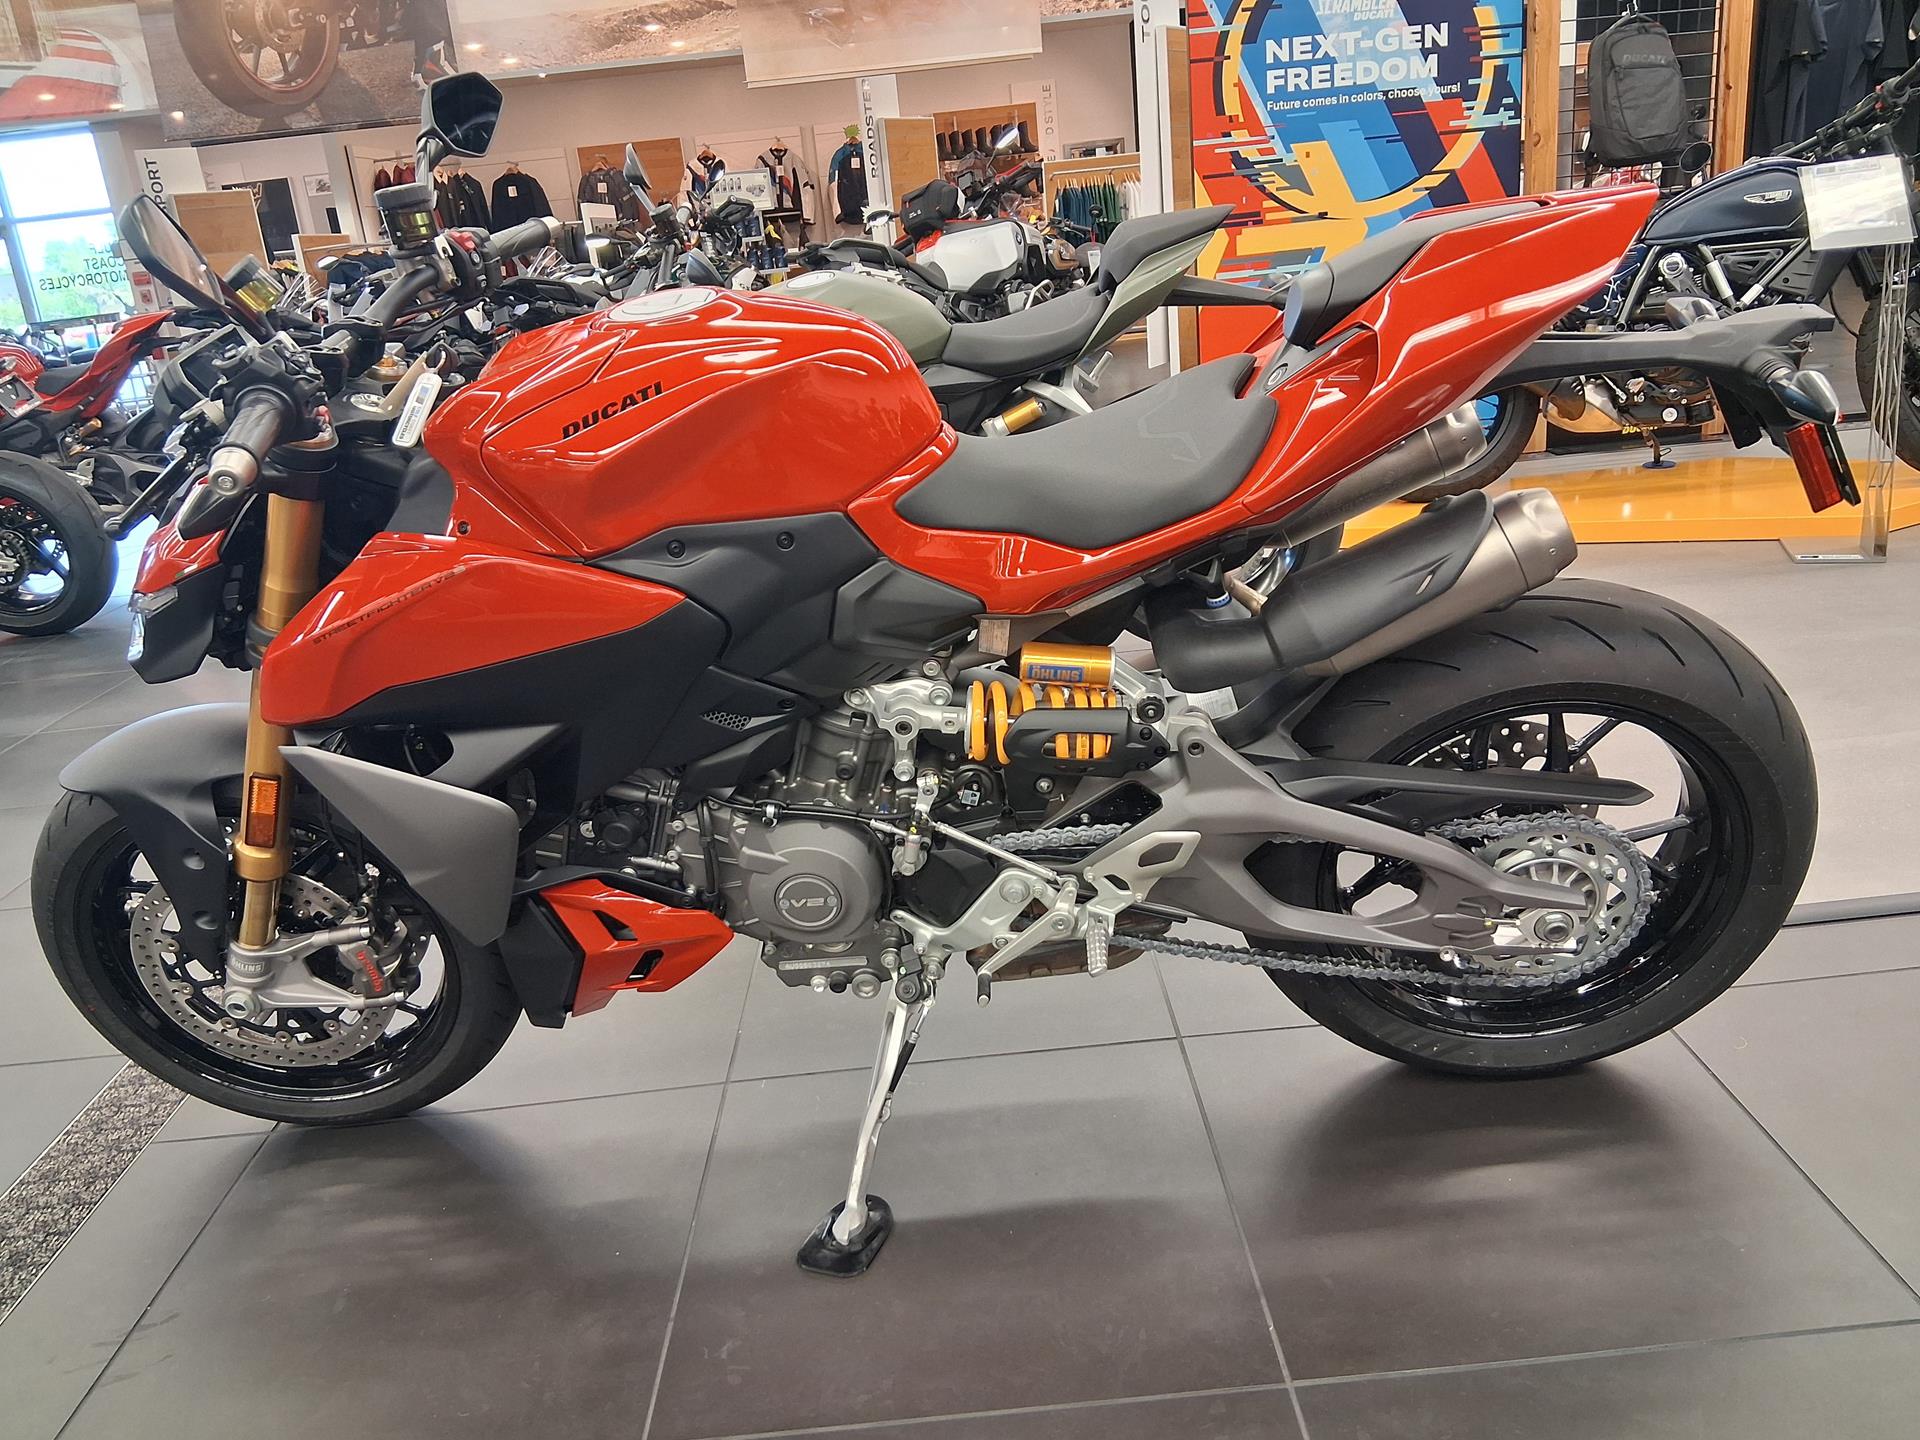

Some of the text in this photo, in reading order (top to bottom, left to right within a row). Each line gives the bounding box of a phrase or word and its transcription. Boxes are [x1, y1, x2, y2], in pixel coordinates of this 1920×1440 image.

[1141, 0, 1150, 43] TO
[1353, 9, 1395, 21] DUCATI
[1265, 22, 1449, 64] NEXT-GEN
[1266, 54, 1438, 95] FREEDOM
[1266, 82, 1461, 111] Future comes in colors, choose yours!
[143, 157, 167, 210] PORT
[562, 380, 663, 440] DUCATI
[312, 580, 432, 645] STREETFIGHTER
[790, 897, 825, 908] V2
[356, 950, 384, 992] brembo
